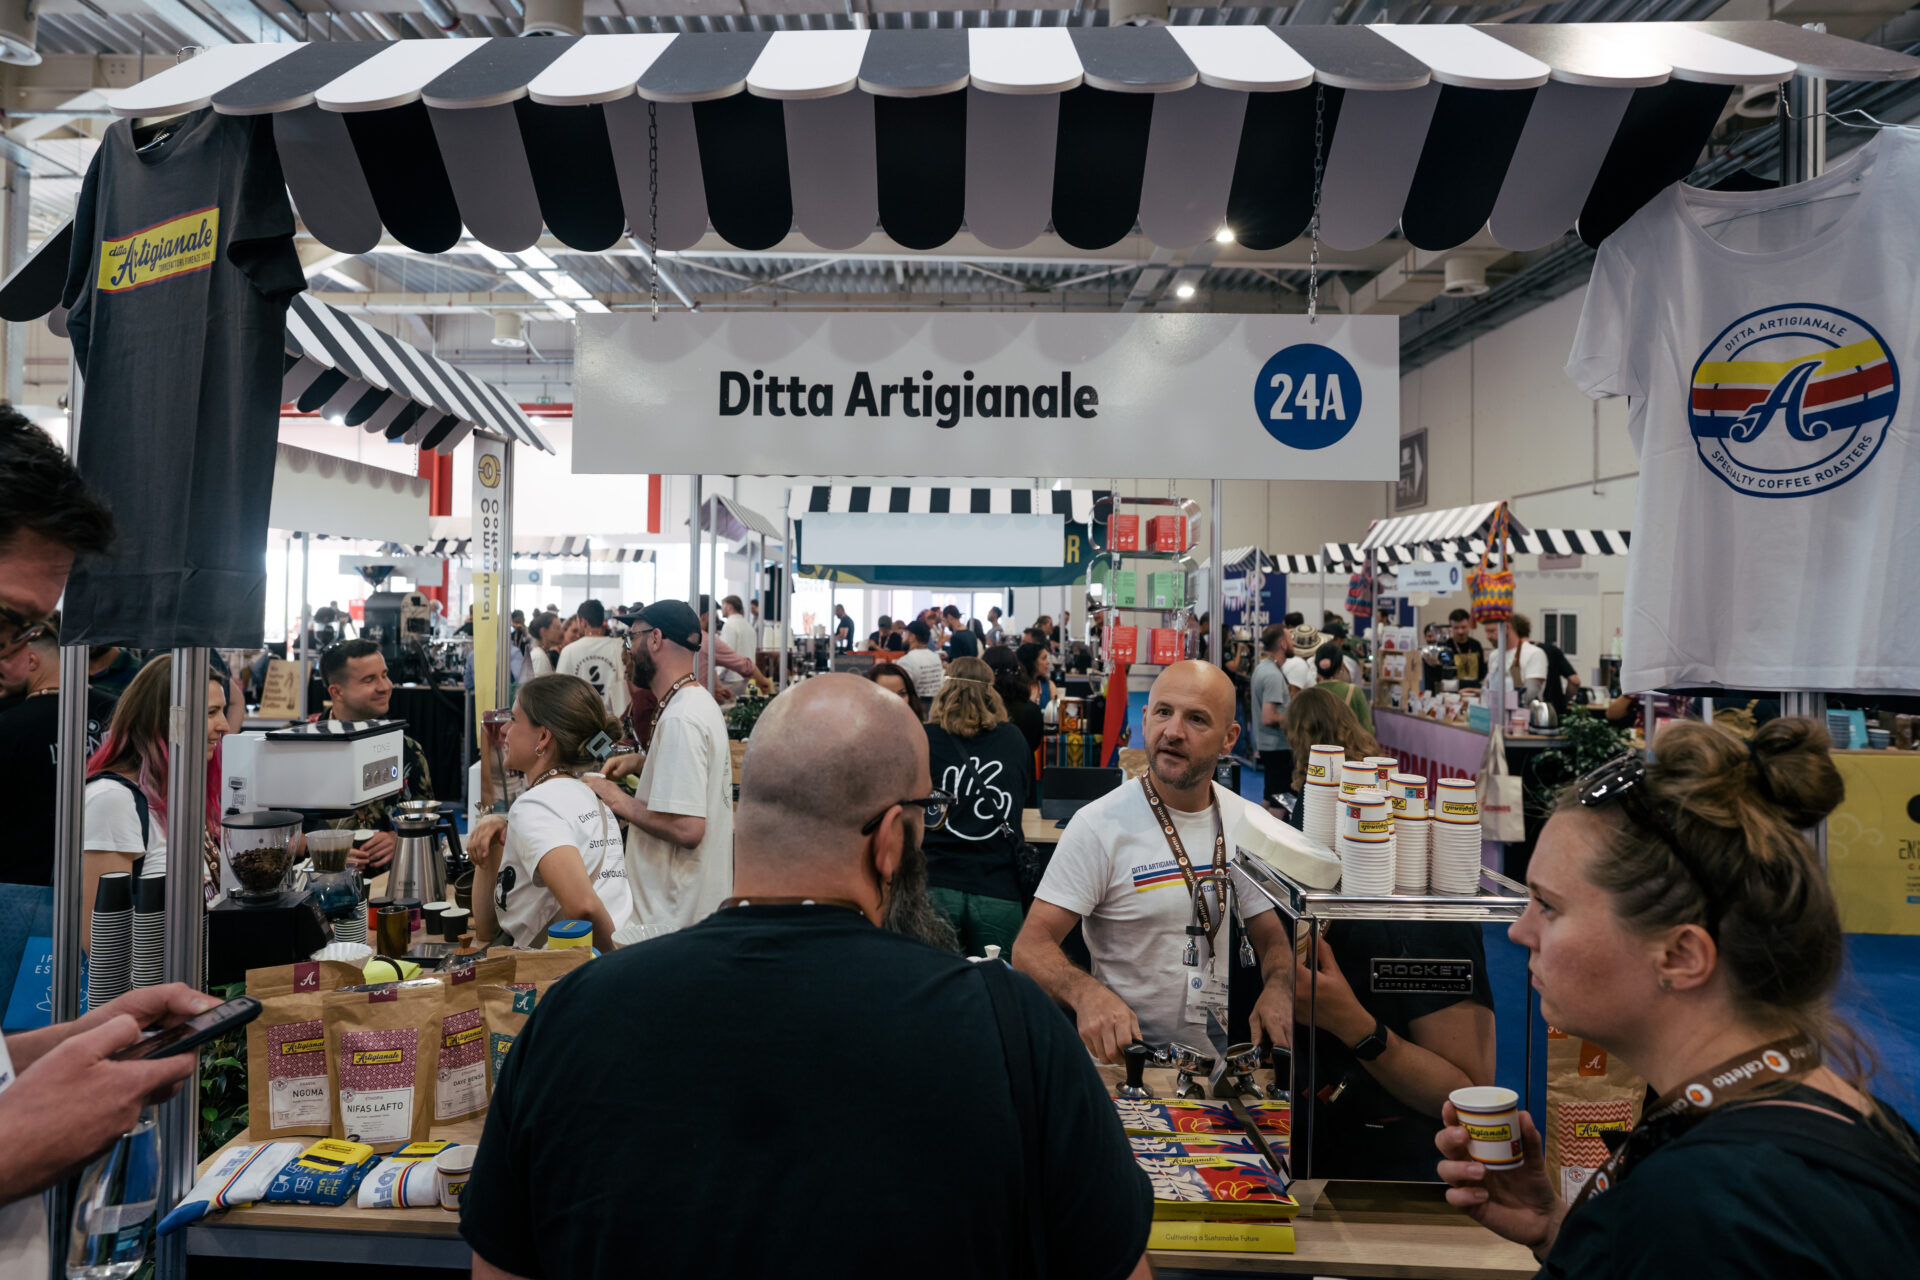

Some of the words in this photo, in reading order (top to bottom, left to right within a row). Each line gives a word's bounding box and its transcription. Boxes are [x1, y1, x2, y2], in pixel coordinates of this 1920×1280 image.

[110, 218, 213, 286] Artigianale
[1724, 327, 1756, 352] DITTA
[1758, 316, 1847, 338] ARTIGIANALE
[719, 369, 834, 417] Ditta
[844, 370, 1099, 429] Artigianale
[1269, 373, 1347, 421] 24A
[1711, 450, 1755, 486] SPECIALTY
[1757, 475, 1812, 489] COFFEE
[1815, 434, 1873, 483] ROASTERS
[1064, 534, 1080, 563] R
[1131, 865, 1148, 874] DITTA
[1378, 964, 1466, 976] ROCKET
[356, 1051, 399, 1064] Artigianale
[1711, 1059, 1765, 1089] cafetto
[292, 1088, 324, 1098] NGOMA
[347, 1105, 372, 1113] NIFAS
[374, 1101, 404, 1112] LAFTO
[1171, 1156, 1216, 1165] Artigianale
[316, 1186, 338, 1196] FEE
[1165, 1233, 1198, 1242] Cultivating
[1204, 1234, 1239, 1242] Sustainable
